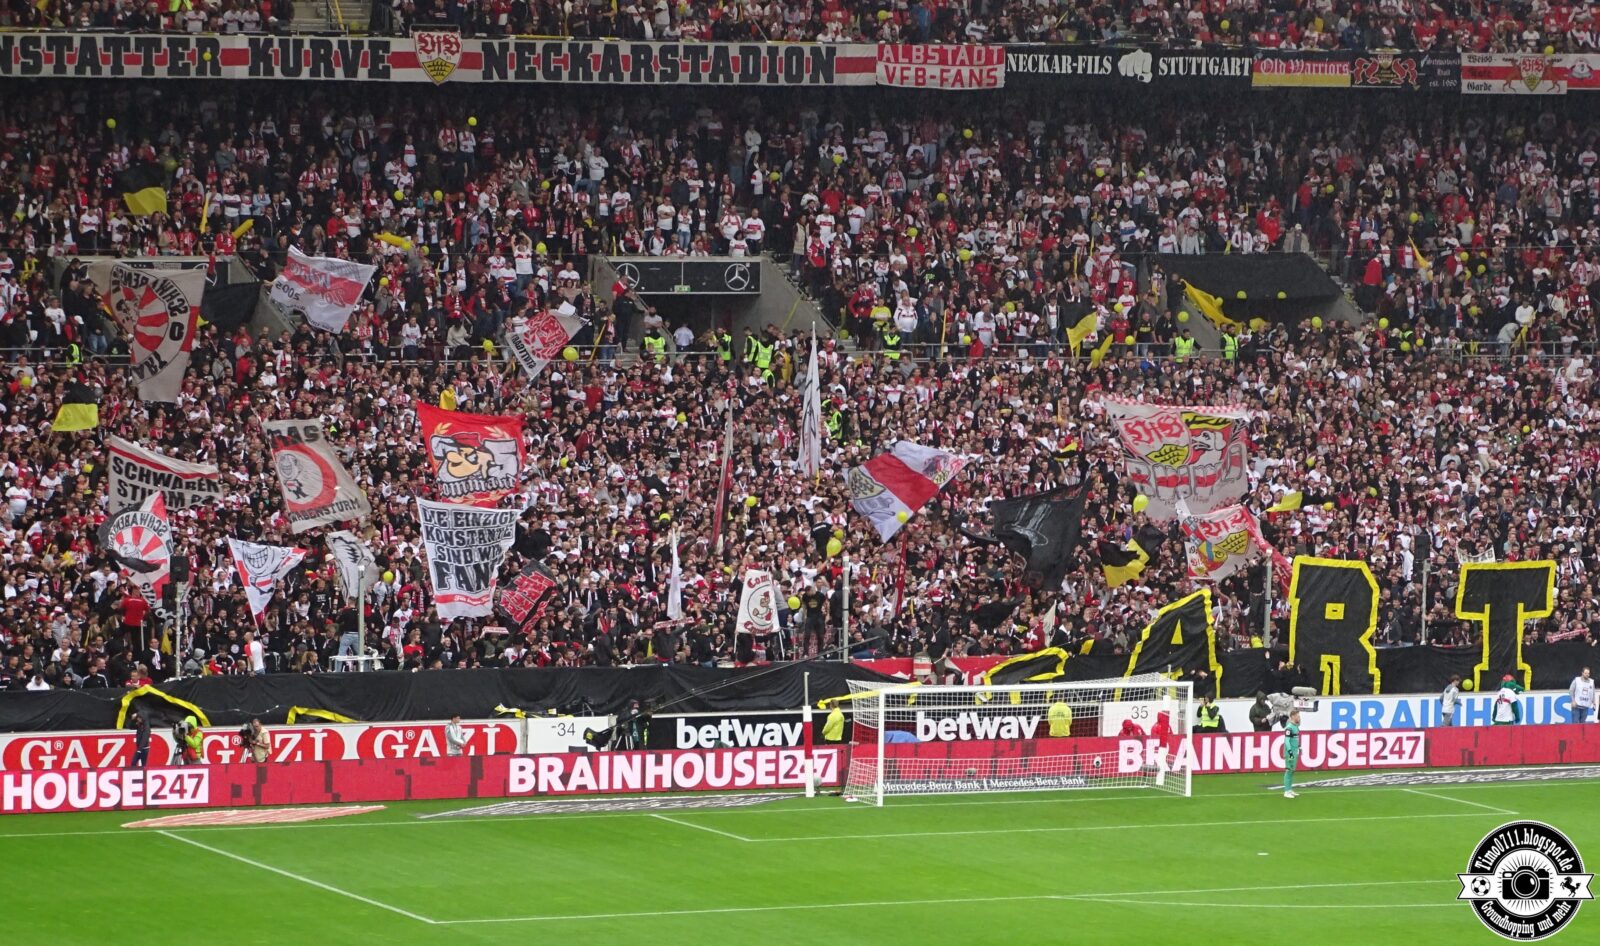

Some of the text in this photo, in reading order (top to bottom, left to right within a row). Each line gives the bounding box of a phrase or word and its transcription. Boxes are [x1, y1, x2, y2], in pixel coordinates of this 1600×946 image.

[249, 38, 391, 79] KURVE
[482, 41, 837, 84] NECKARSTADION
[882, 44, 1003, 65] ALBSTADT
[1007, 53, 1252, 77] NECKAR-FILS STUTTGART
[884, 65, 998, 88] VFB-FANS
[1260, 58, 1350, 76] Old Warriors
[112, 455, 220, 493] SCHWABEN
[437, 545, 473, 564] SIND
[1131, 706, 1149, 720] 35
[676, 717, 803, 749] betway
[916, 710, 1041, 742] betway
[955, 779, 980, 790] Bank
[990, 776, 1085, 788] Mercedes-Benz Bank
